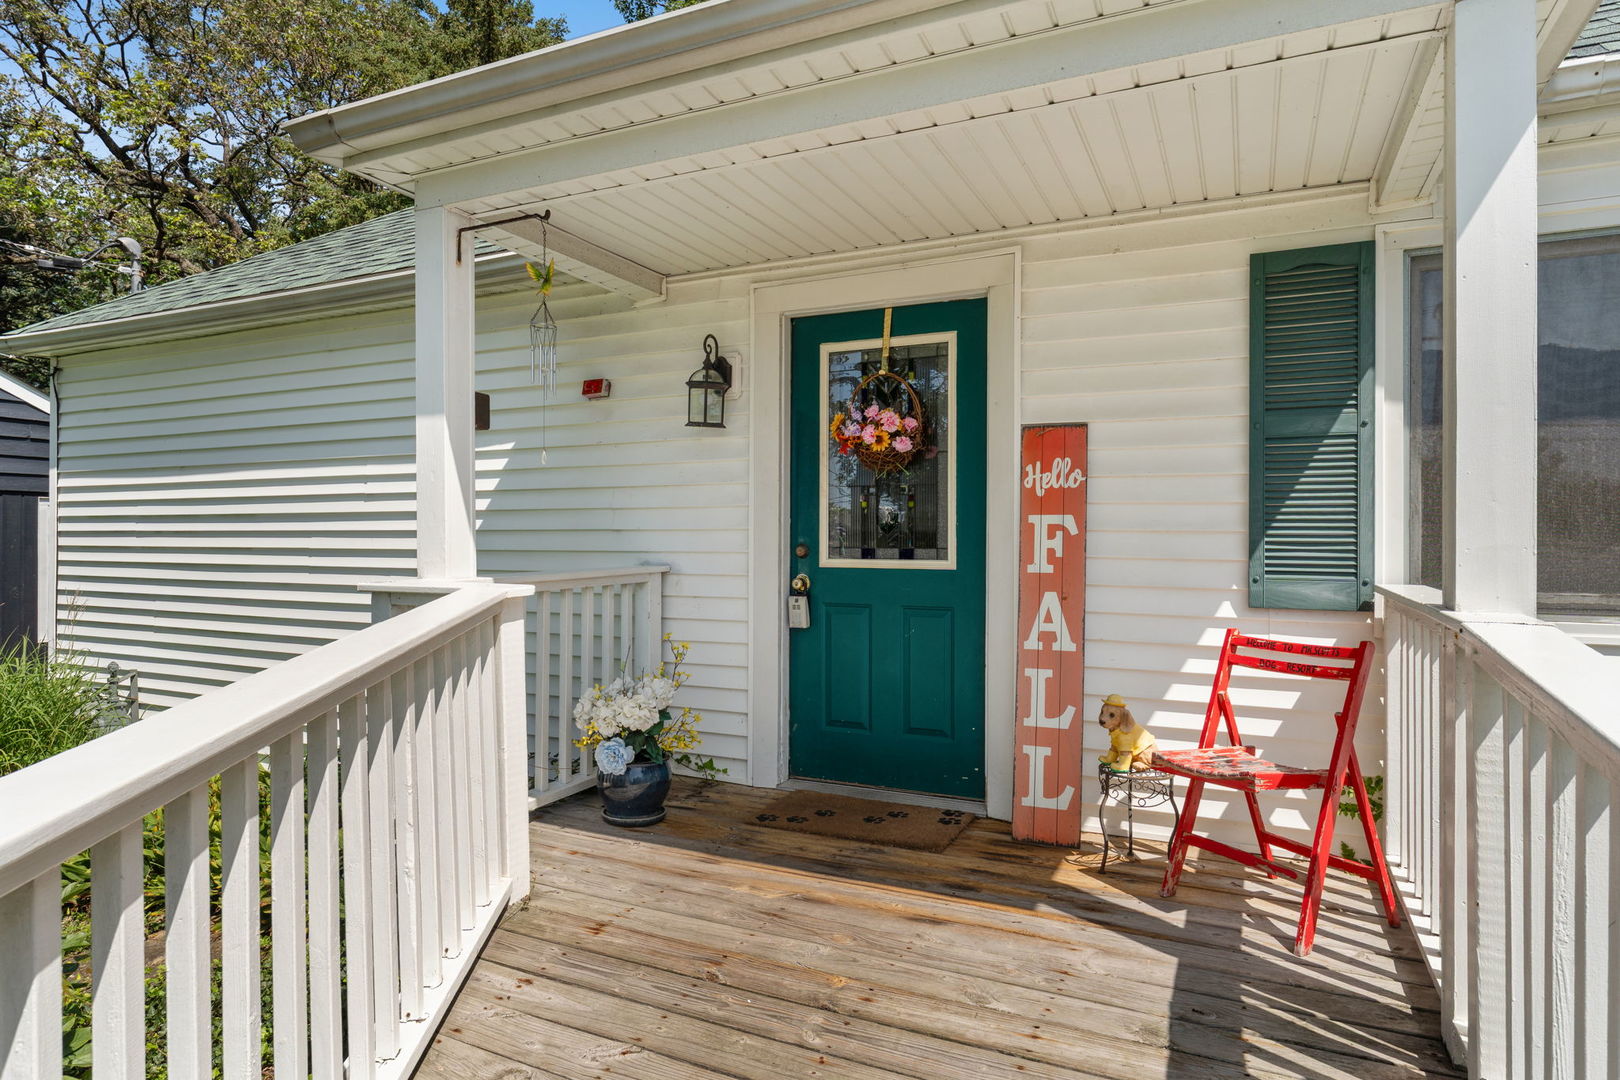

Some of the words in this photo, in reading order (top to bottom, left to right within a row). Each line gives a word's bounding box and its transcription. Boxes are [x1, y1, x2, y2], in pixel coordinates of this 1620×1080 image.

[1024, 457, 1087, 497] Hello
[1283, 643, 1293, 652] TO
[1022, 514, 1079, 811] FALL
[1259, 659, 1276, 669] DOG
[1286, 662, 1318, 673] RESORT
